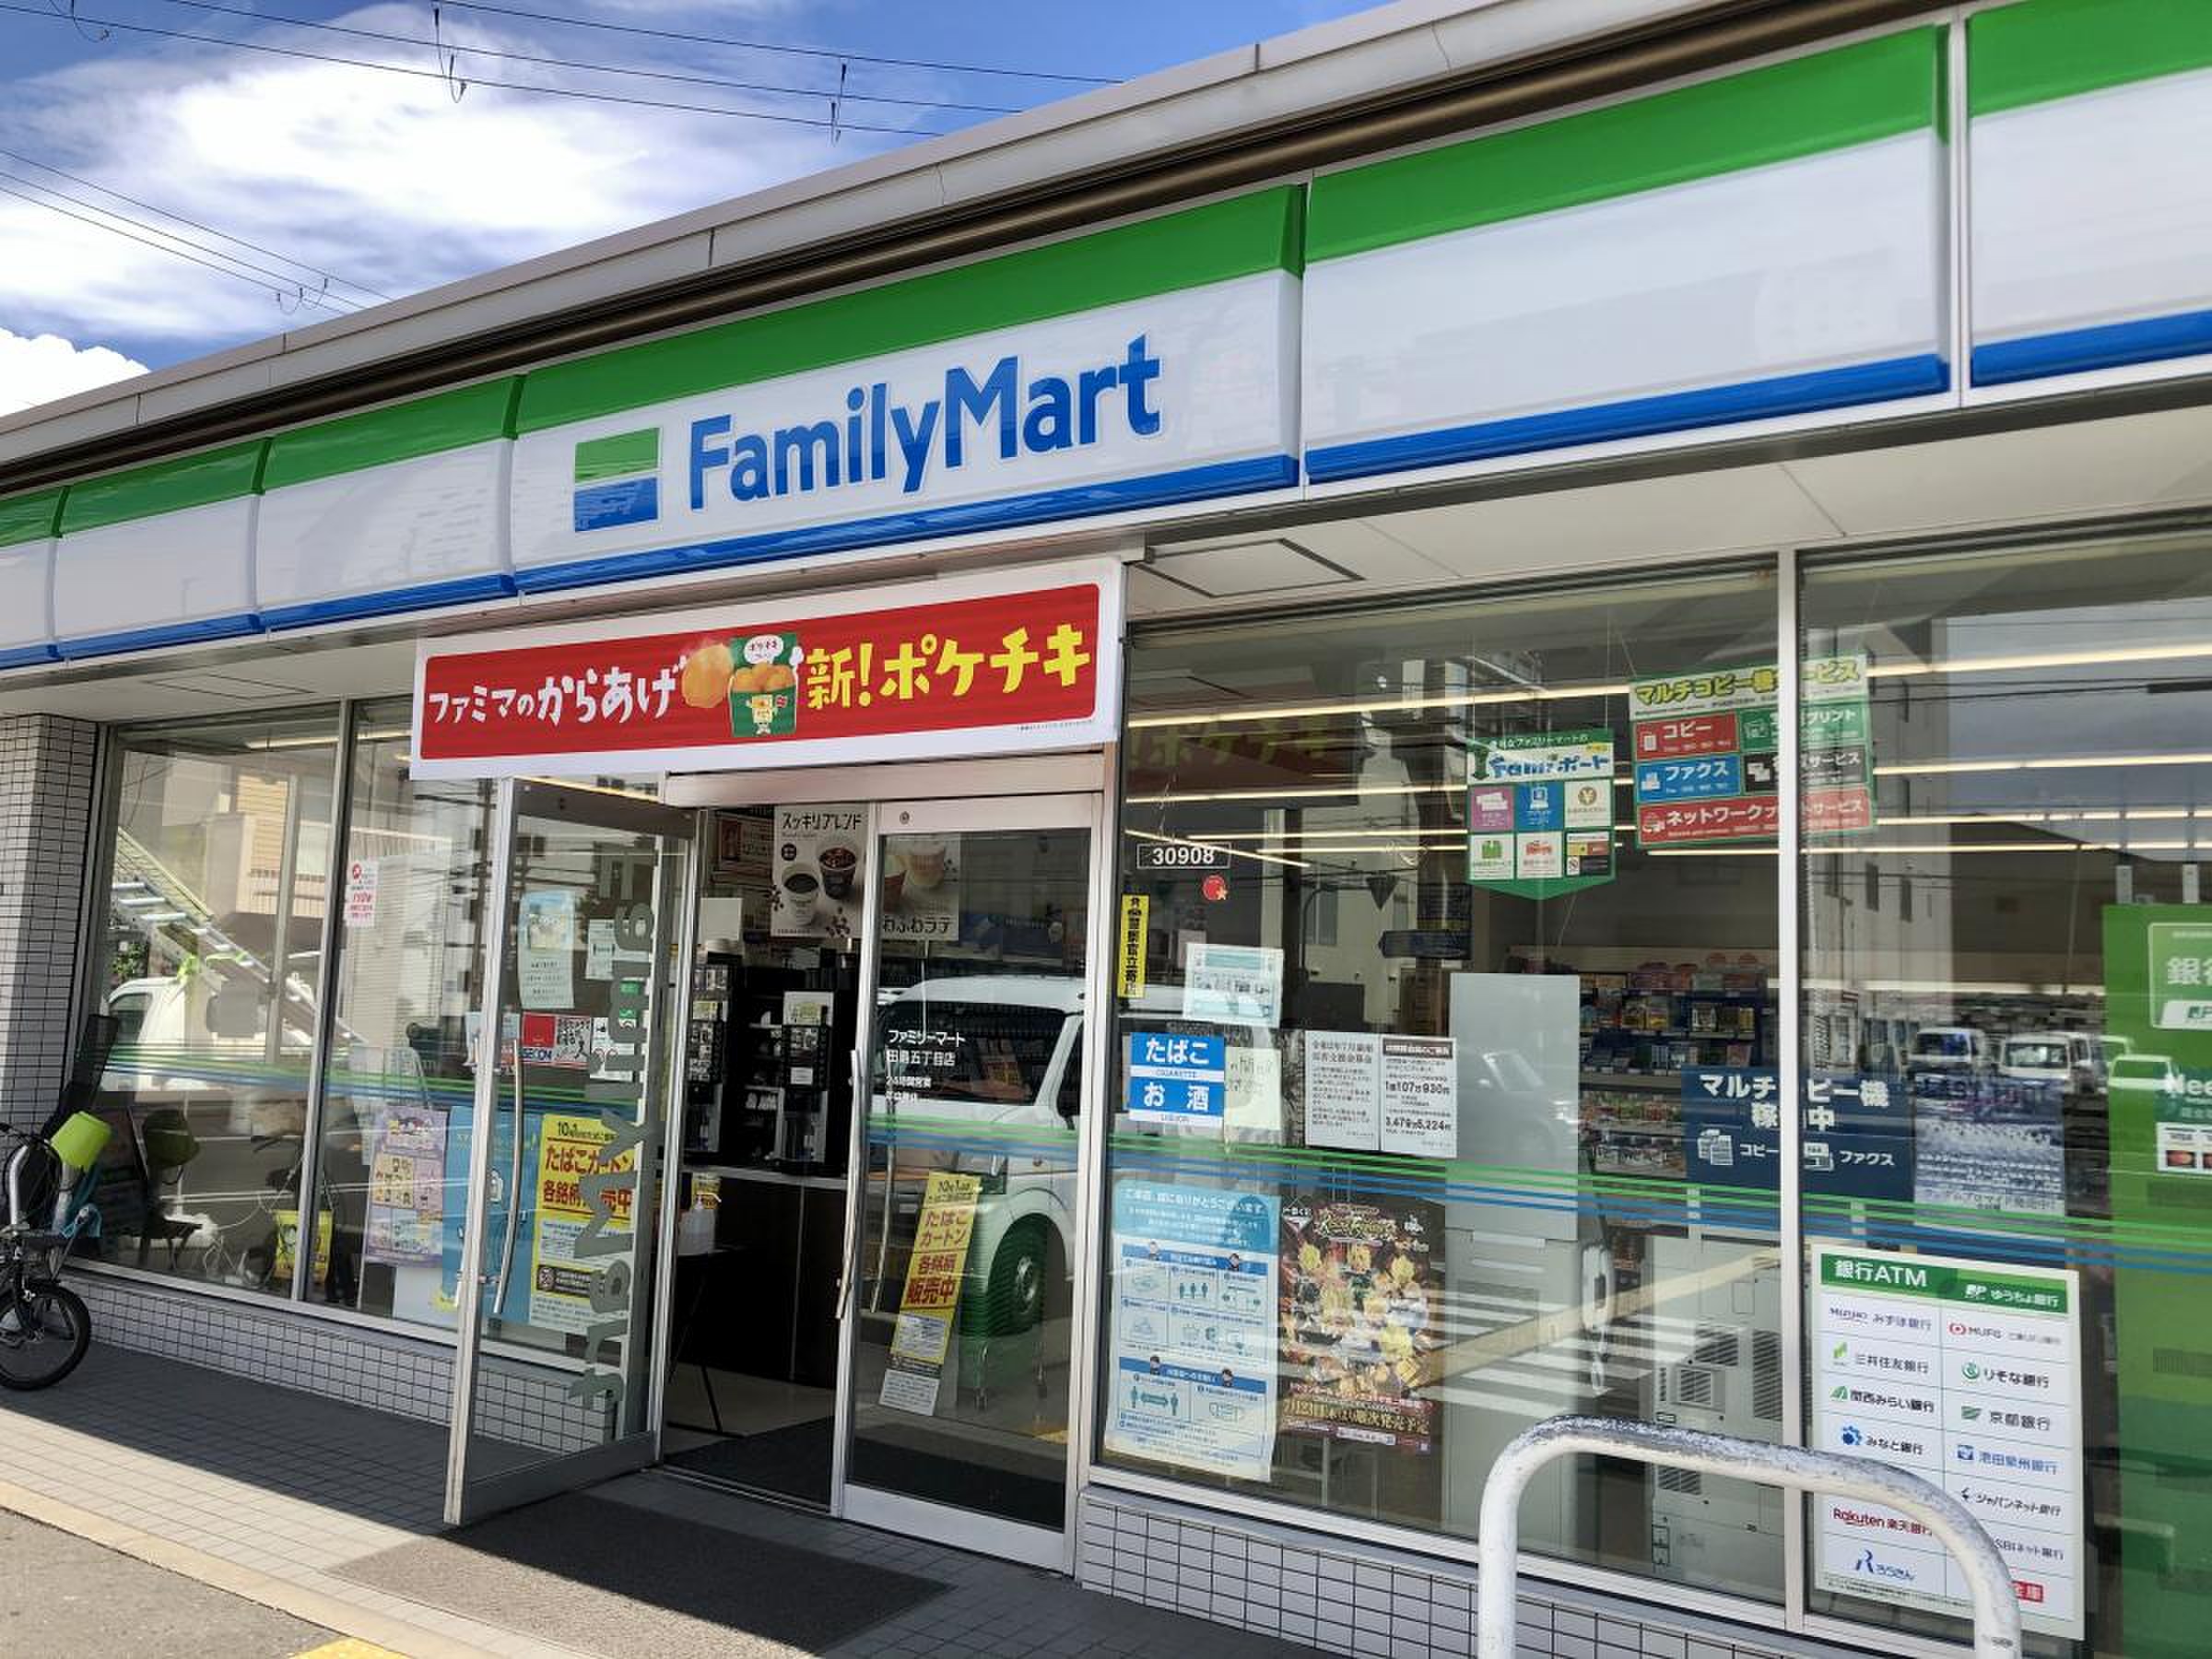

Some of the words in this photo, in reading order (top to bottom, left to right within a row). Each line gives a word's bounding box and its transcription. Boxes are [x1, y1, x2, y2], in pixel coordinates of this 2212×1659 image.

[690, 334, 1160, 511] FamilyMart
[429, 655, 688, 726] ファミマのからあげ
[1663, 721, 1712, 739] コピー
[1665, 759, 1729, 782] ファクス
[1151, 846, 1216, 865] 30908
[888, 1030, 966, 1047] ファミリーマート
[1146, 1038, 1209, 1065] たばこ
[1700, 1073, 1889, 1109] マルチピー機
[1751, 1101, 1835, 1132] 稼中
[1740, 1143, 1780, 1159] コピー
[1839, 1149, 1896, 1167] ファクス
[1834, 1259, 1927, 1288] 銀行ATM
[1832, 1507, 1885, 1528] Rakuten
